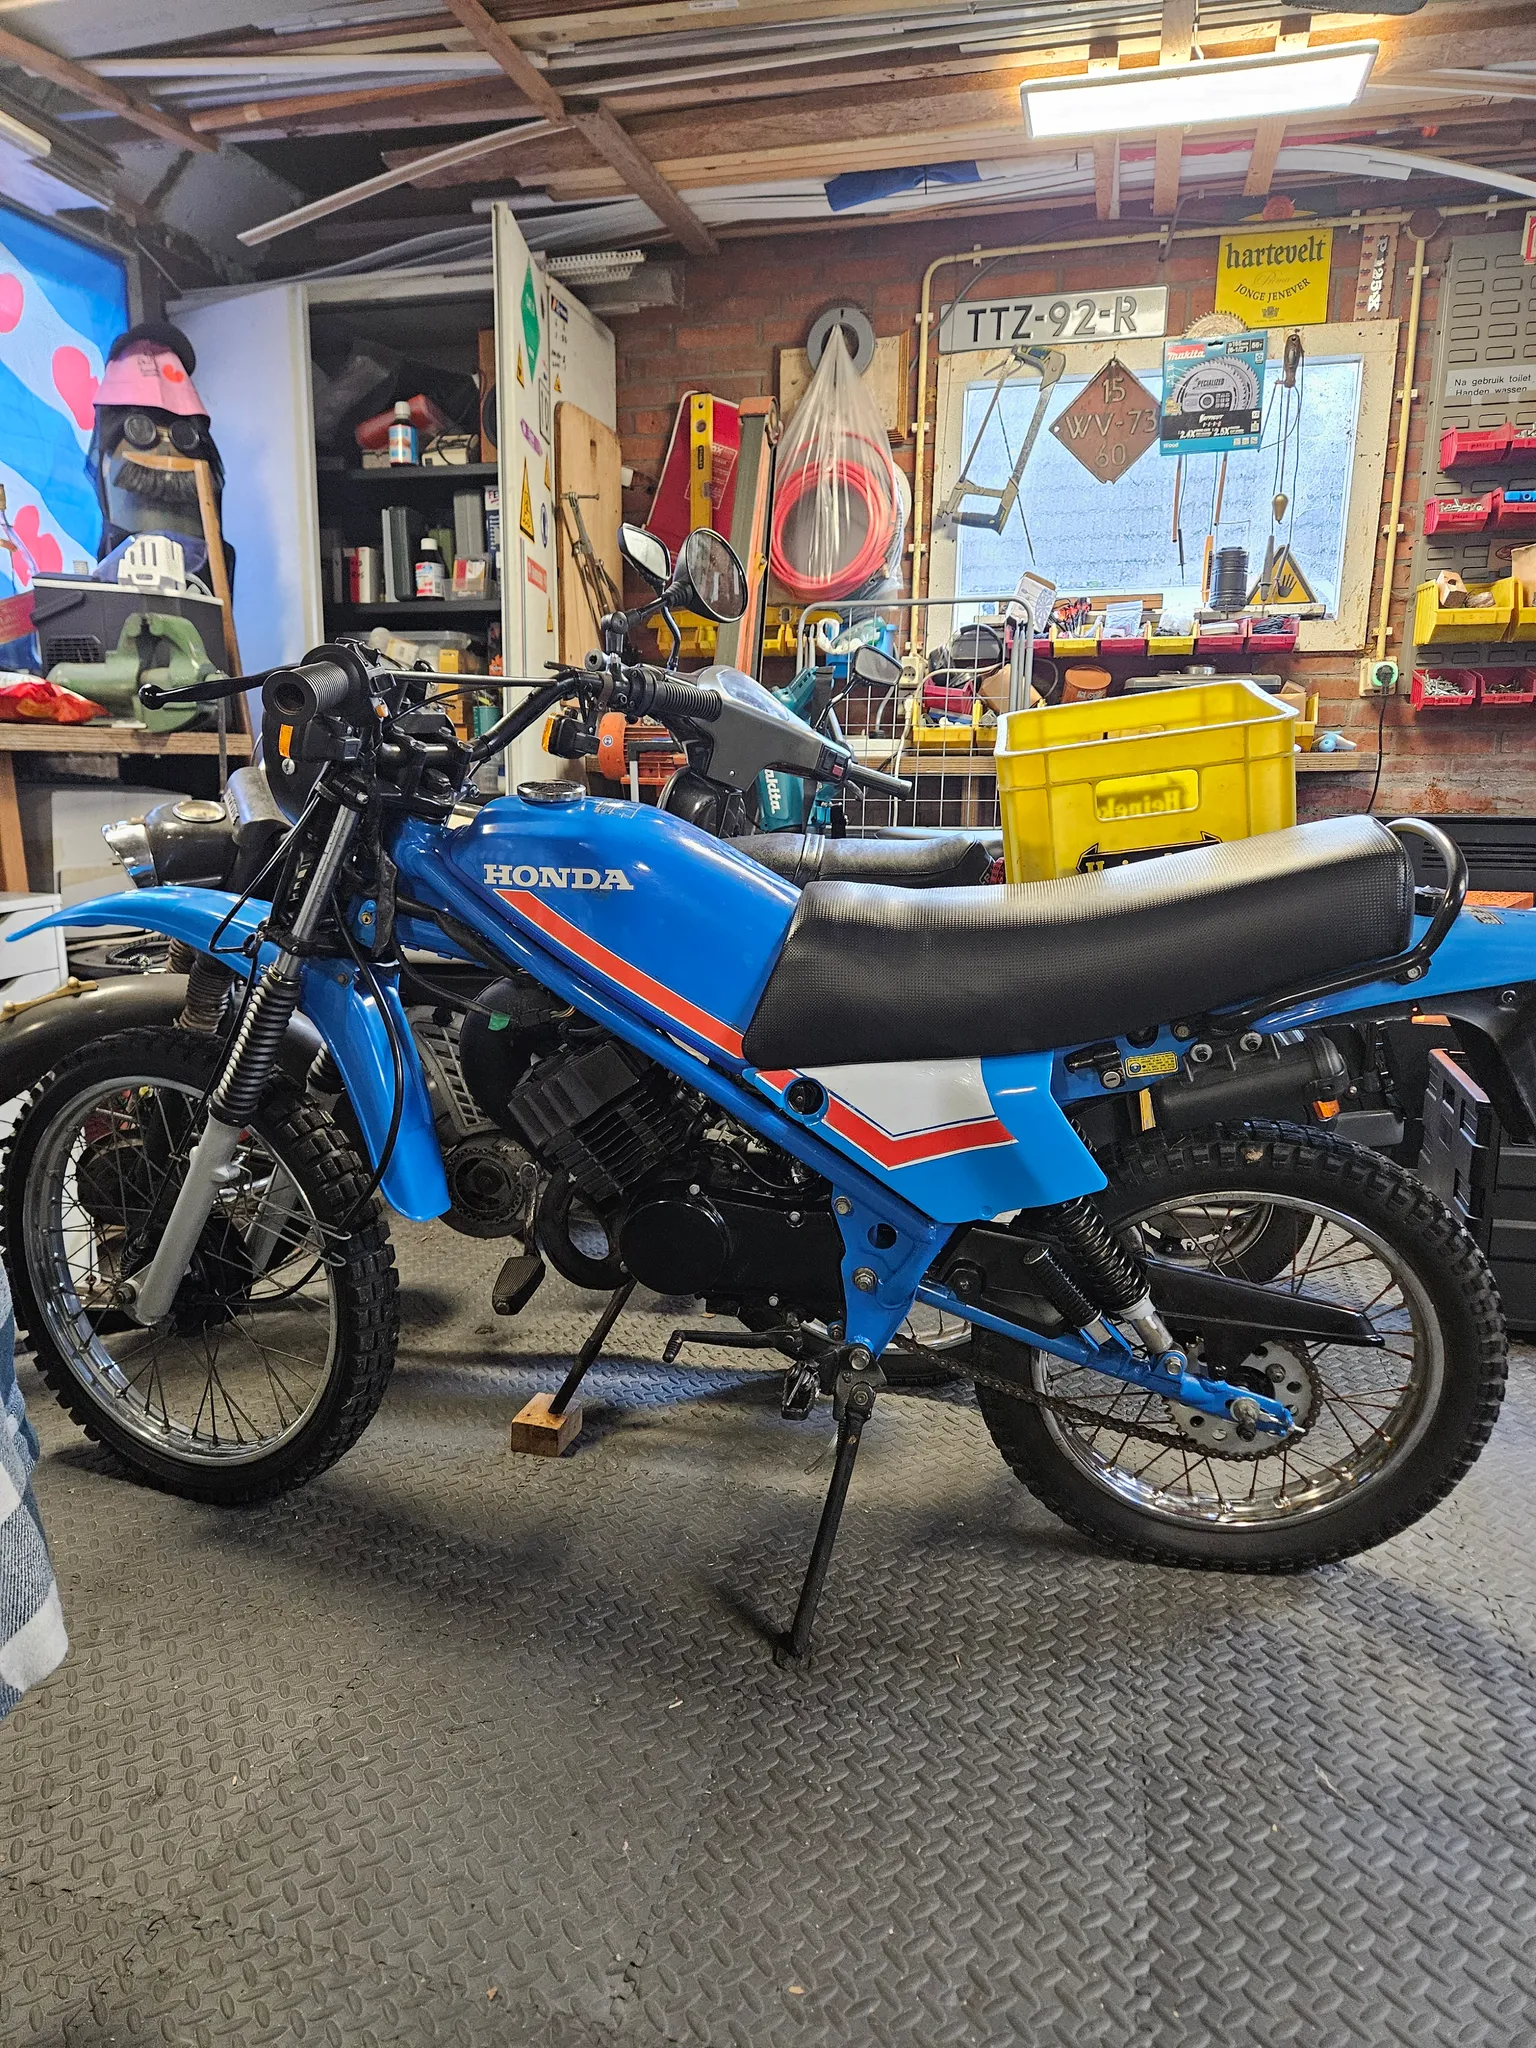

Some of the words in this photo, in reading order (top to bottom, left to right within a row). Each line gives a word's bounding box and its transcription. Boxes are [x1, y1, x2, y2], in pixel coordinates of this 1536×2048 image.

[1225, 235, 1326, 269] hartevelt
[1234, 283, 1266, 302] JONGE
[1267, 277, 1311, 303] JENEVER
[967, 295, 1138, 343] TTZ-92-R
[1102, 378, 1127, 404] 15
[1456, 388, 1490, 396] Handen
[1494, 386, 1528, 394] wassen
[1472, 376, 1504, 387] gebruik
[1065, 408, 1158, 440] WV-73
[1094, 442, 1126, 468] 60
[483, 864, 634, 891] HONDA
